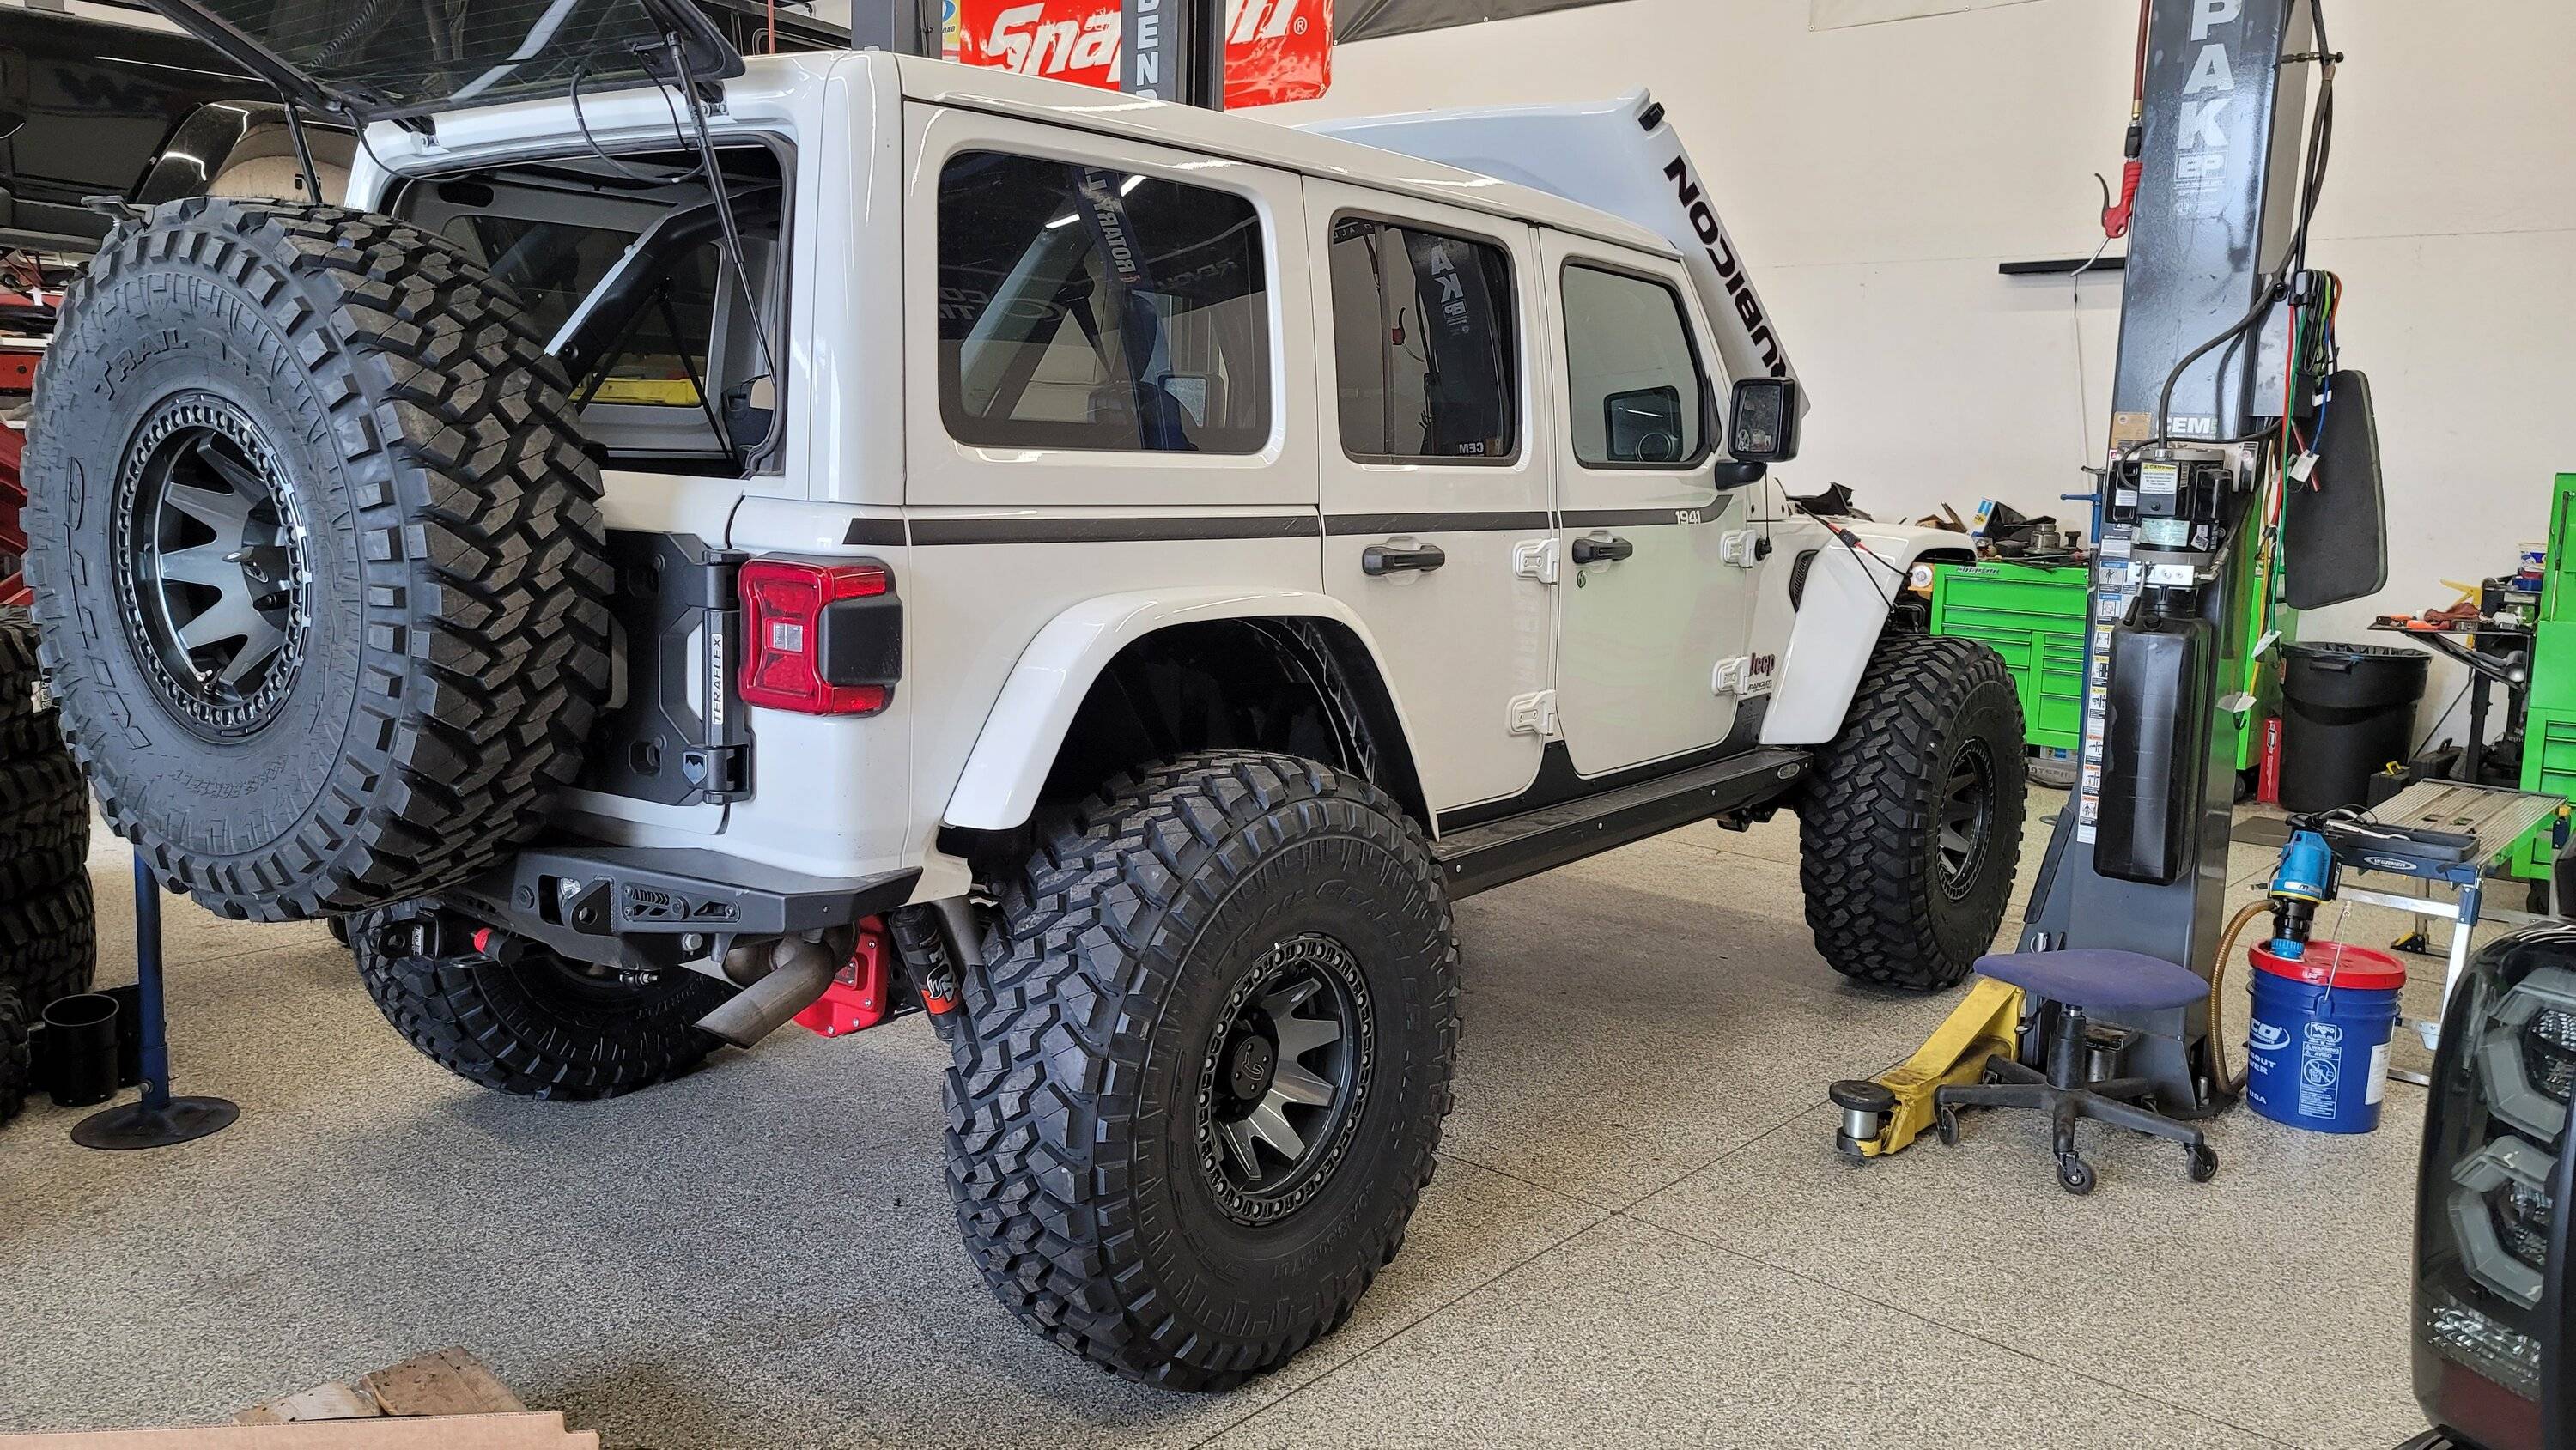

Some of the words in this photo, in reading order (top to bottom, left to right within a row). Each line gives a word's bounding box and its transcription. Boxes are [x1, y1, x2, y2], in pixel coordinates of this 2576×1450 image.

[2177, 0, 2242, 150] PAK
[1675, 510, 1701, 525] 1941
[1749, 652, 1775, 676] Jeep
[713, 636, 722, 724] TERAFLEX
[2373, 858, 2406, 868] WERNER
[927, 942, 961, 1003] FOX
[2312, 1045, 2339, 1054] WARNING
